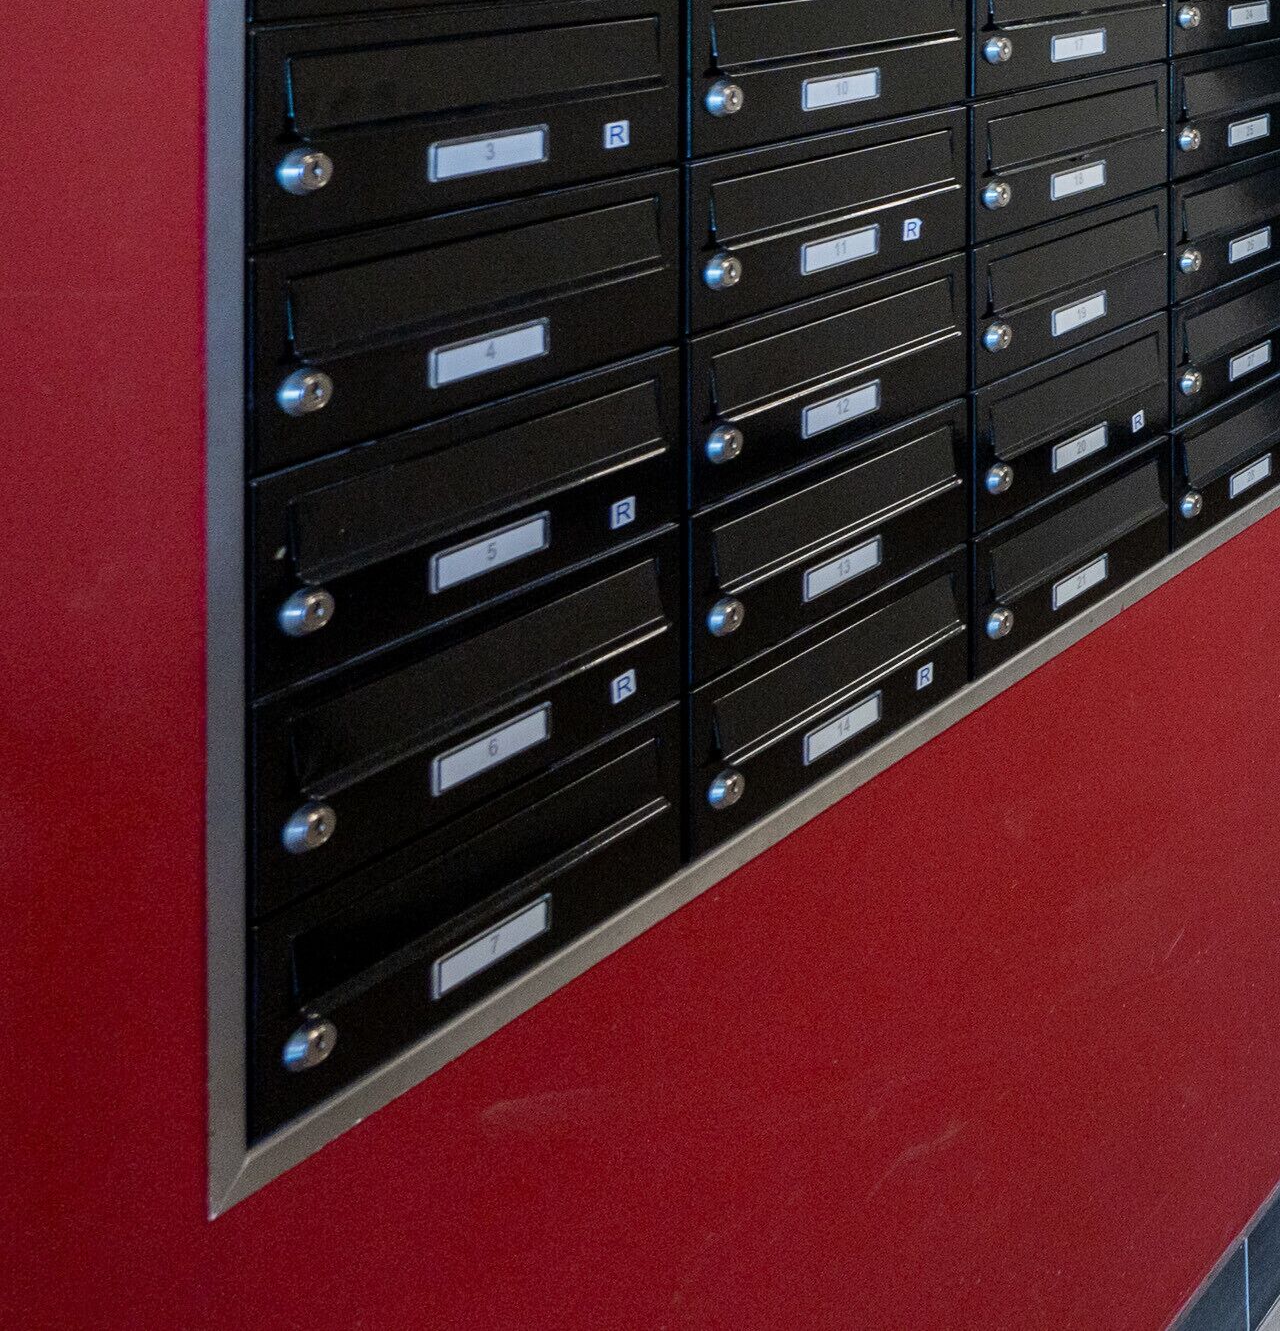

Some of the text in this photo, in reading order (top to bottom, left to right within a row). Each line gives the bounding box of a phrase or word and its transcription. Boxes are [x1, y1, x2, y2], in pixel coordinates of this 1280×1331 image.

[836, 81, 848, 96] 10
[609, 125, 624, 145] R
[485, 142, 496, 160] 3
[906, 221, 917, 238] R
[834, 240, 847, 256] 11
[1076, 306, 1087, 320] 19
[485, 341, 497, 360] 4
[836, 398, 849, 415] 12
[1134, 414, 1143, 430] R
[1076, 439, 1087, 455] 20
[616, 502, 631, 524] R
[486, 542, 497, 561] 5
[837, 559, 851, 577] 13
[920, 667, 930, 685] R
[617, 674, 632, 698] R
[837, 717, 851, 737] 14
[487, 739, 498, 757] 6
[489, 935, 498, 954] 7
